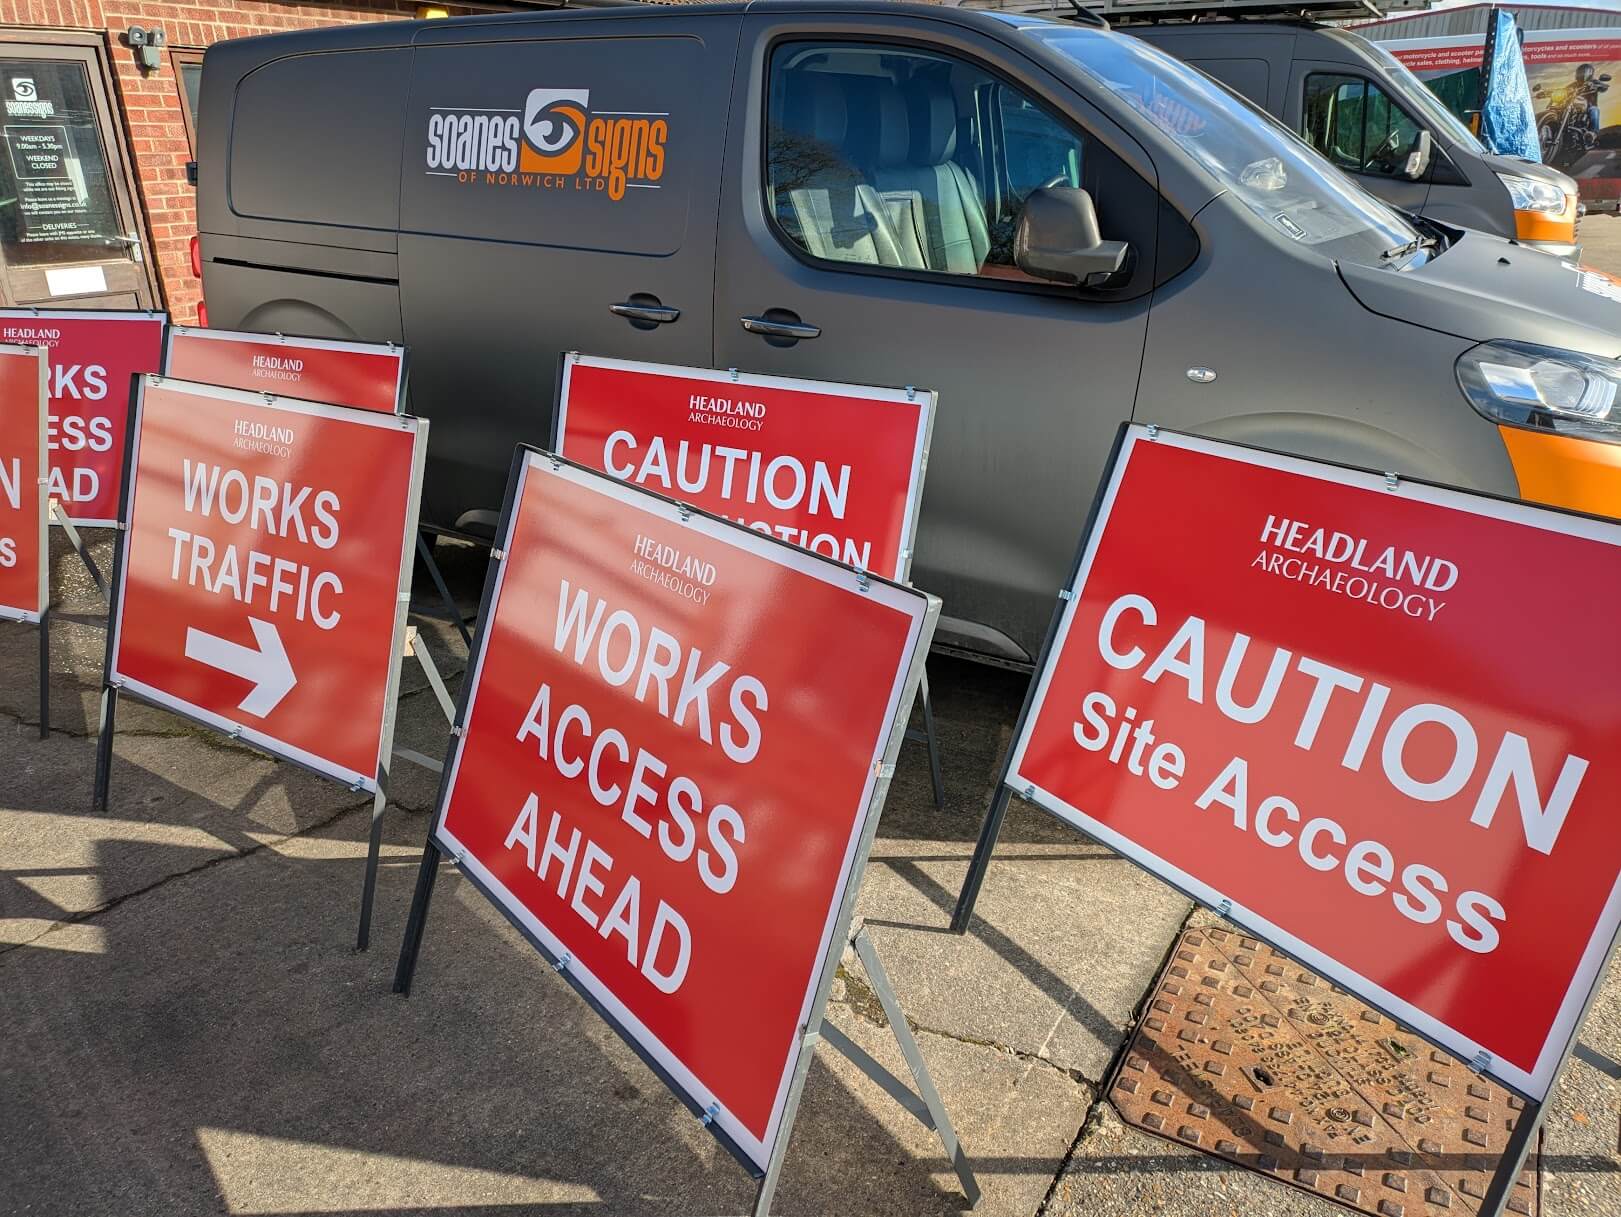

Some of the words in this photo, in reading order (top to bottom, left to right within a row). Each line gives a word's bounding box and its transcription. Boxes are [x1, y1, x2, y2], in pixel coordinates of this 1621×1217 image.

[427, 114, 519, 173] soanes
[586, 118, 668, 200] signs
[458, 172, 477, 183] OF
[486, 172, 566, 189] NORWICH
[575, 178, 605, 191] LTD
[3, 327, 61, 339] HEADLAND
[252, 355, 304, 372] HEADLAND
[234, 419, 294, 445] HEADLAND
[688, 394, 767, 419] HEADLAND
[688, 411, 764, 432] ARCHAEOLOGY
[233, 437, 293, 459] ARCHAEOLOGY
[603, 430, 851, 520] CAUTION
[183, 458, 341, 550] WORKS
[168, 527, 344, 631] TRAFFIC
[630, 559, 712, 606] ARCHAEOLOGY
[634, 534, 717, 587] HEADLAND
[1251, 550, 1447, 622] ARCHAEOLOGY
[1260, 514, 1460, 593] HEADLAND
[553, 579, 769, 764] WORKS
[1098, 593, 1590, 857] CAUTION
[515, 683, 746, 895] ACCESS
[1073, 691, 1186, 790] Site
[1195, 756, 1507, 954] Access
[503, 791, 693, 995] AHEAD
